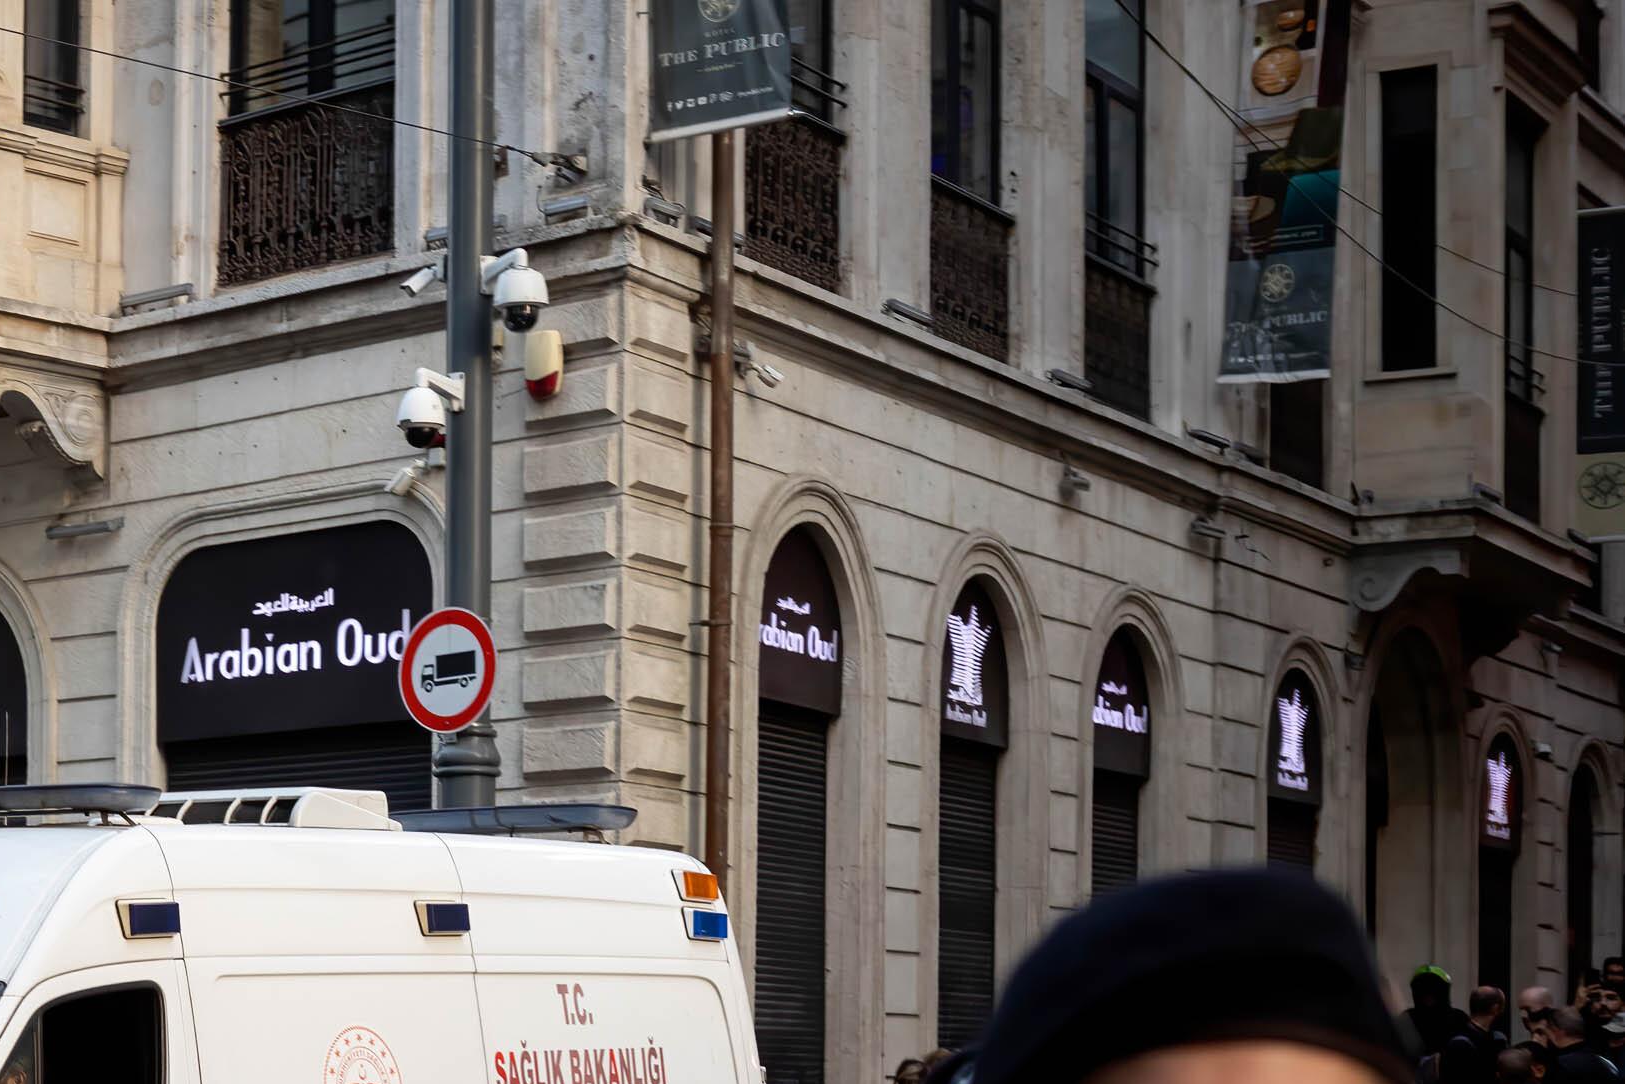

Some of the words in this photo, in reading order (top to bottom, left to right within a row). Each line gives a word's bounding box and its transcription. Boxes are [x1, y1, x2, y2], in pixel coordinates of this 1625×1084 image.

[658, 50, 698, 67] THE
[703, 33, 786, 59] PUBLIC
[180, 627, 322, 685] Arabian
[336, 608, 411, 668] Oud
[759, 612, 805, 655] rabian
[807, 625, 838, 662] Oud
[556, 983, 594, 1027] T.C.
